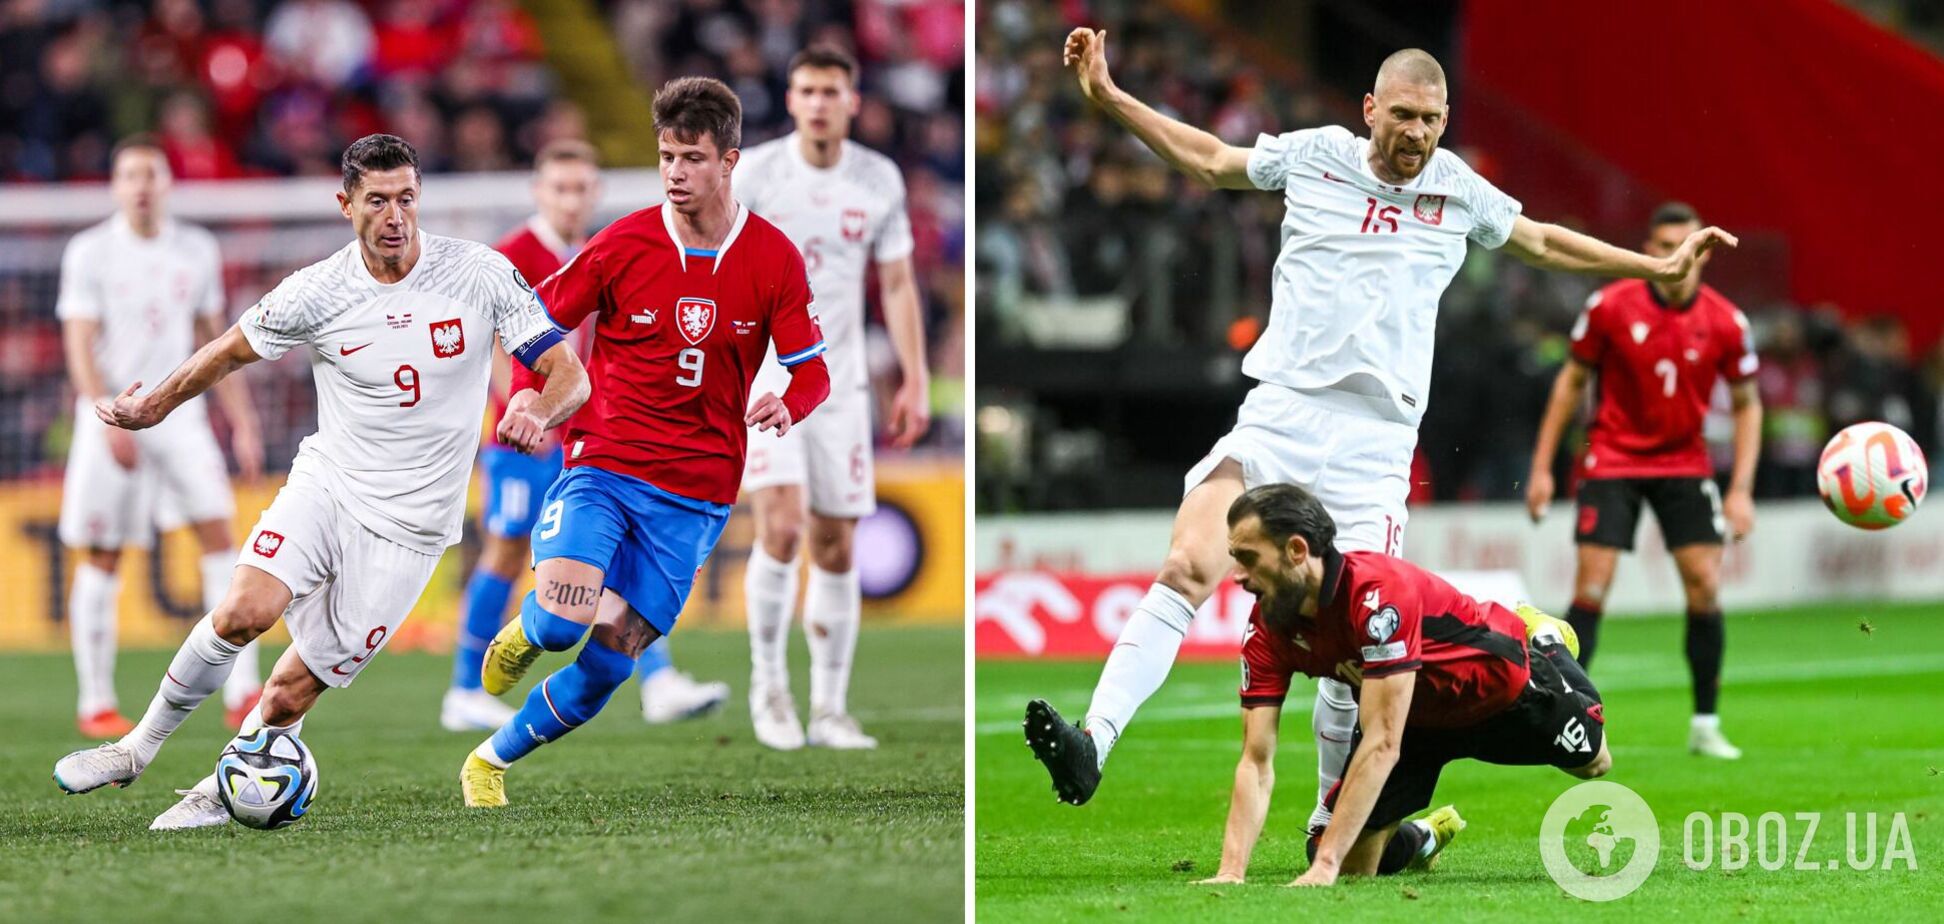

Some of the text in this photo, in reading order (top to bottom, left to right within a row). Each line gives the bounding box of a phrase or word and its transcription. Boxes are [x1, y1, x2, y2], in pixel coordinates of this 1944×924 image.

[1361, 197, 1402, 233] 15
[393, 364, 421, 408] 9
[675, 347, 706, 388] 9
[1654, 358, 1678, 398] 7
[540, 499, 564, 540] 9
[545, 579, 597, 607] 2002
[351, 625, 387, 664] 9
[1553, 716, 1586, 753] 16
